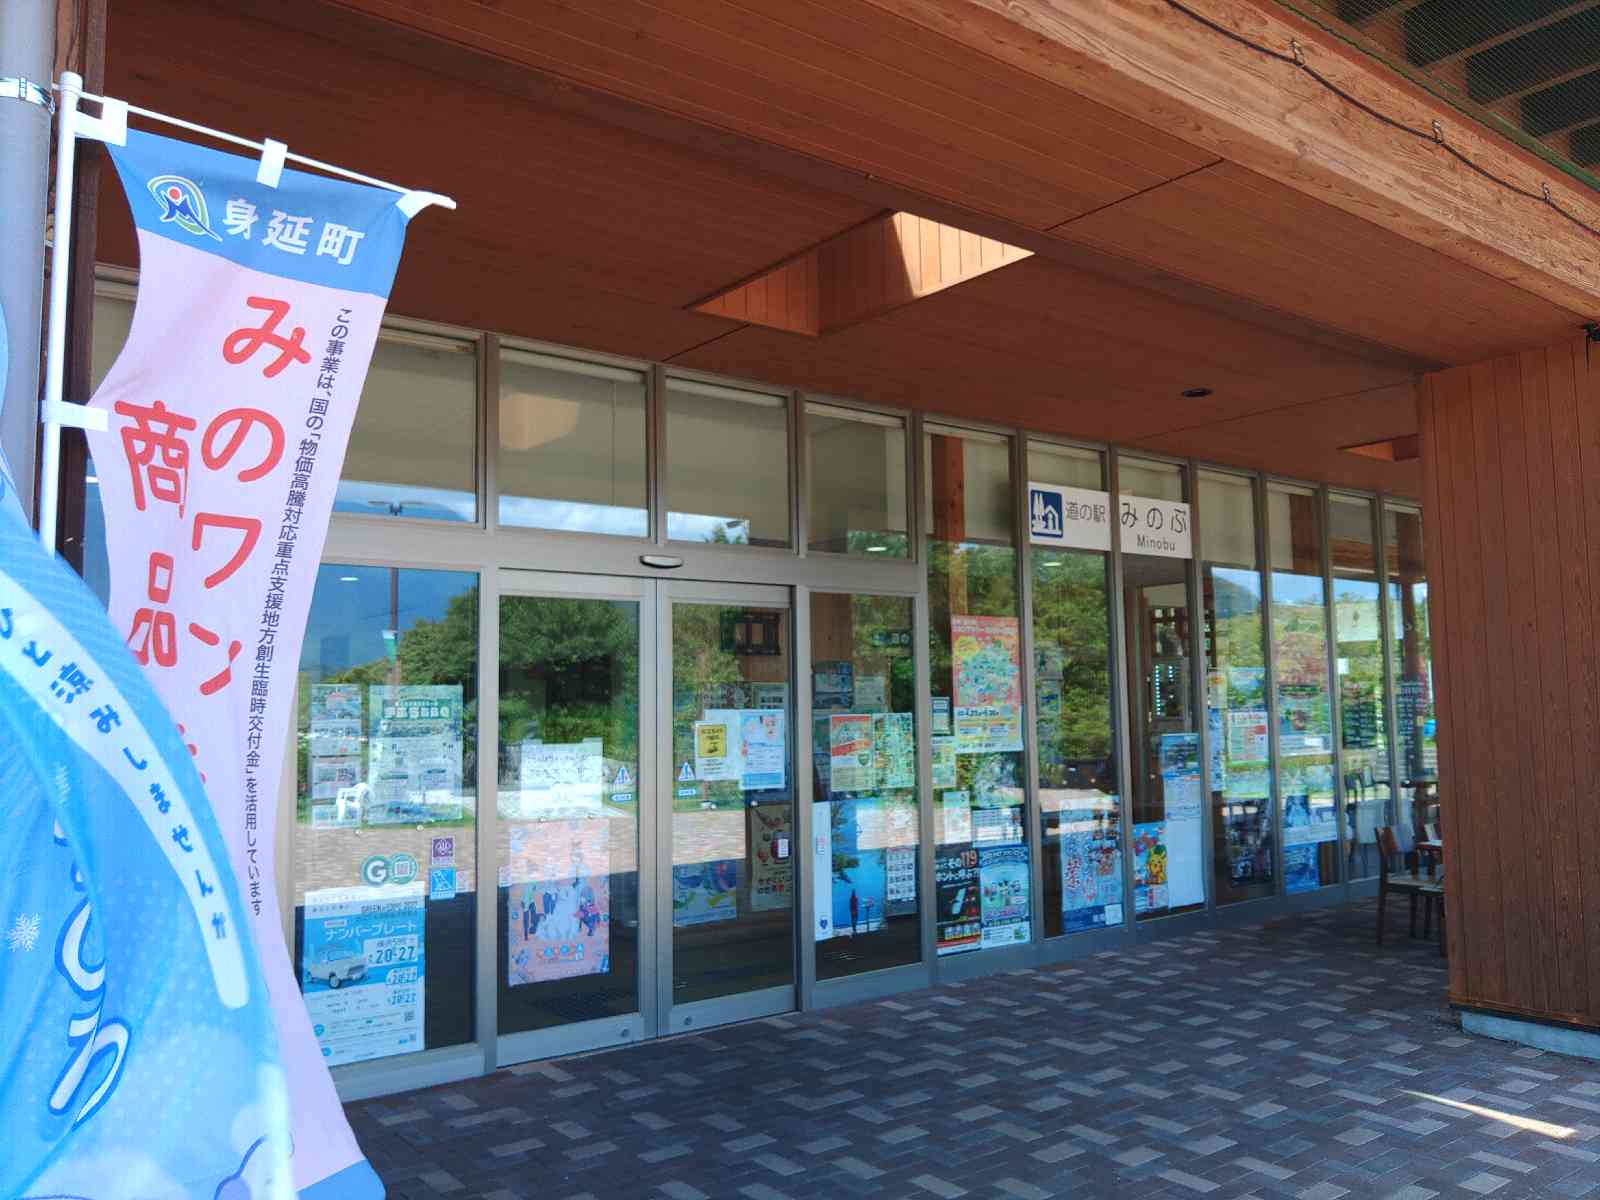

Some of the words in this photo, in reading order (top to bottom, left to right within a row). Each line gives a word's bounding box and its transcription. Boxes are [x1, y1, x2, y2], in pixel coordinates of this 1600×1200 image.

[222, 197, 365, 265] 身延町
[1066, 501, 1106, 524] 道の駅
[1120, 502, 1187, 533] みのぶ
[1137, 534, 1176, 551] Minobu
